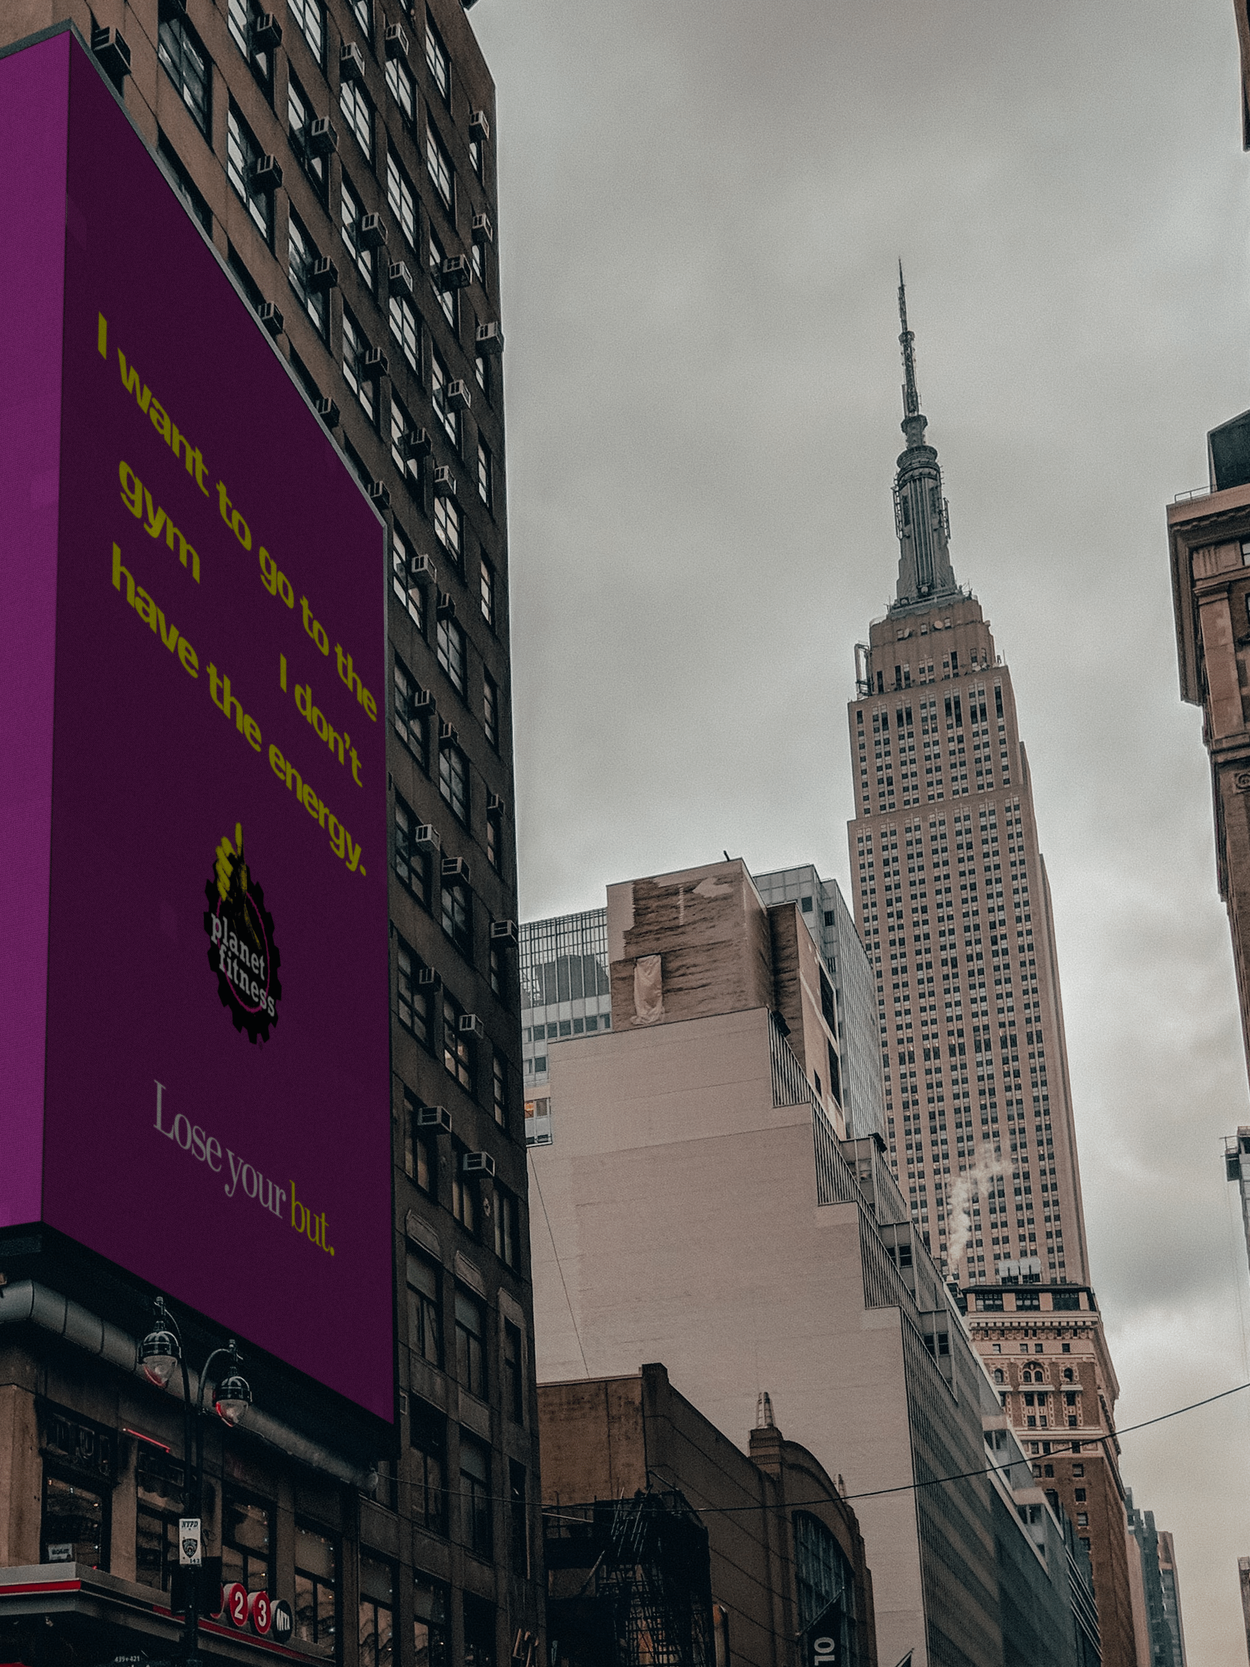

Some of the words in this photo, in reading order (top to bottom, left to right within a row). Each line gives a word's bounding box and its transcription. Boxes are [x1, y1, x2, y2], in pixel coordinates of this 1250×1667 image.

[97, 311, 108, 360] I
[117, 347, 210, 498] want
[215, 480, 252, 551] to
[258, 546, 295, 609] go
[299, 595, 330, 657] to
[334, 642, 378, 722] the
[118, 460, 201, 584] gym
[279, 653, 288, 693] I
[111, 541, 199, 679] have
[206, 661, 262, 753] the
[268, 743, 367, 877] energy.
[211, 913, 265, 981] planet
[219, 945, 275, 1017] fitness
[153, 1079, 223, 1173] Lose
[224, 1148, 287, 1219] your
[289, 1179, 335, 1257] but.
[234, 1591, 244, 1620] 2
[257, 1599, 268, 1627] 3
[276, 1607, 291, 1632] MTA
